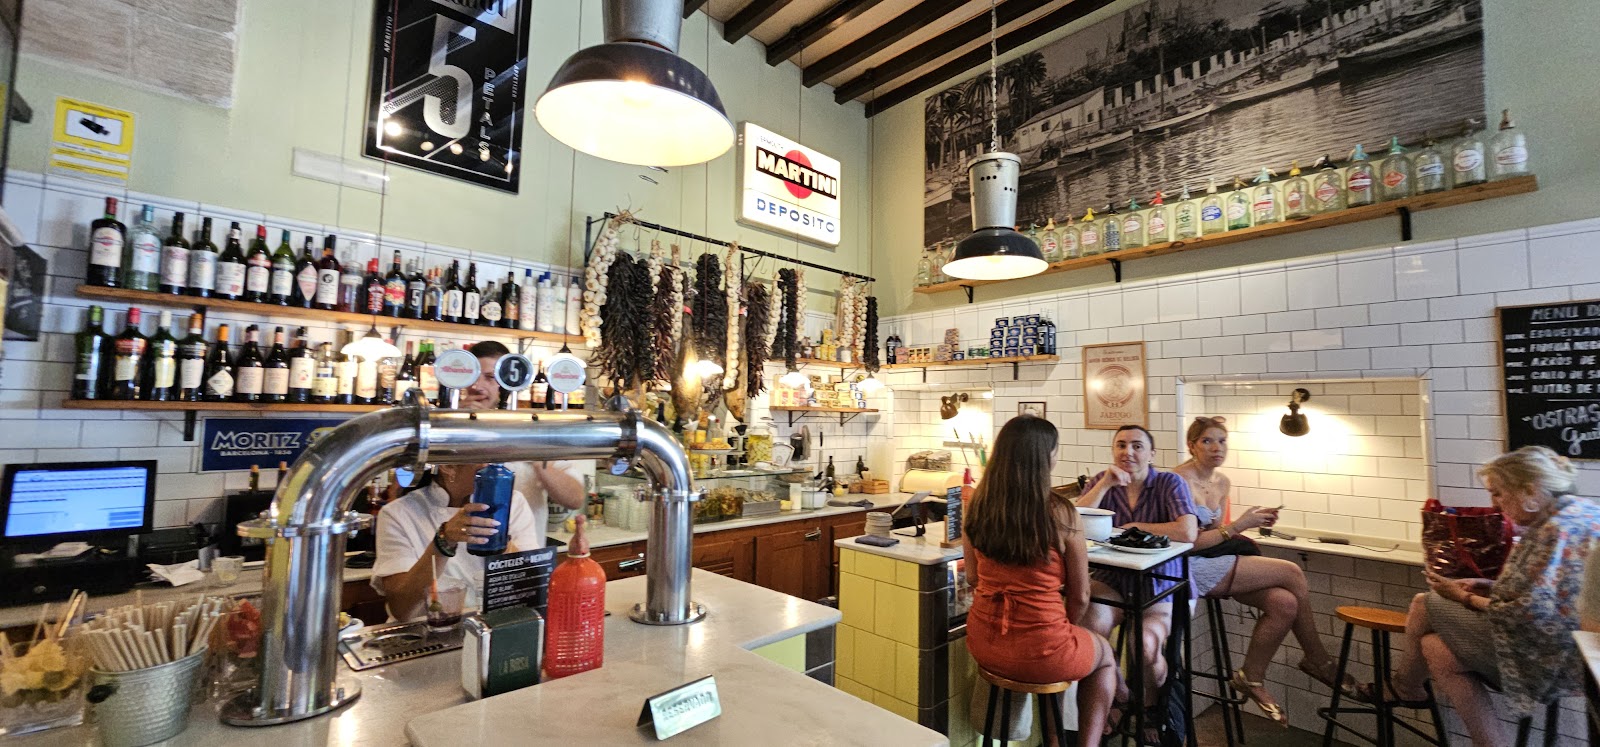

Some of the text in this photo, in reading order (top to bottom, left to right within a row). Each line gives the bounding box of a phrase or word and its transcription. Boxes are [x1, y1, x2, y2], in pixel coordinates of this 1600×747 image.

[384, 15, 393, 53] APERITIVO
[422, 13, 477, 140] 5
[757, 148, 838, 198] MARTINI
[508, 359, 520, 383] 5
[210, 430, 303, 450] MORITZ
[487, 556, 525, 571] CÓCTELES
